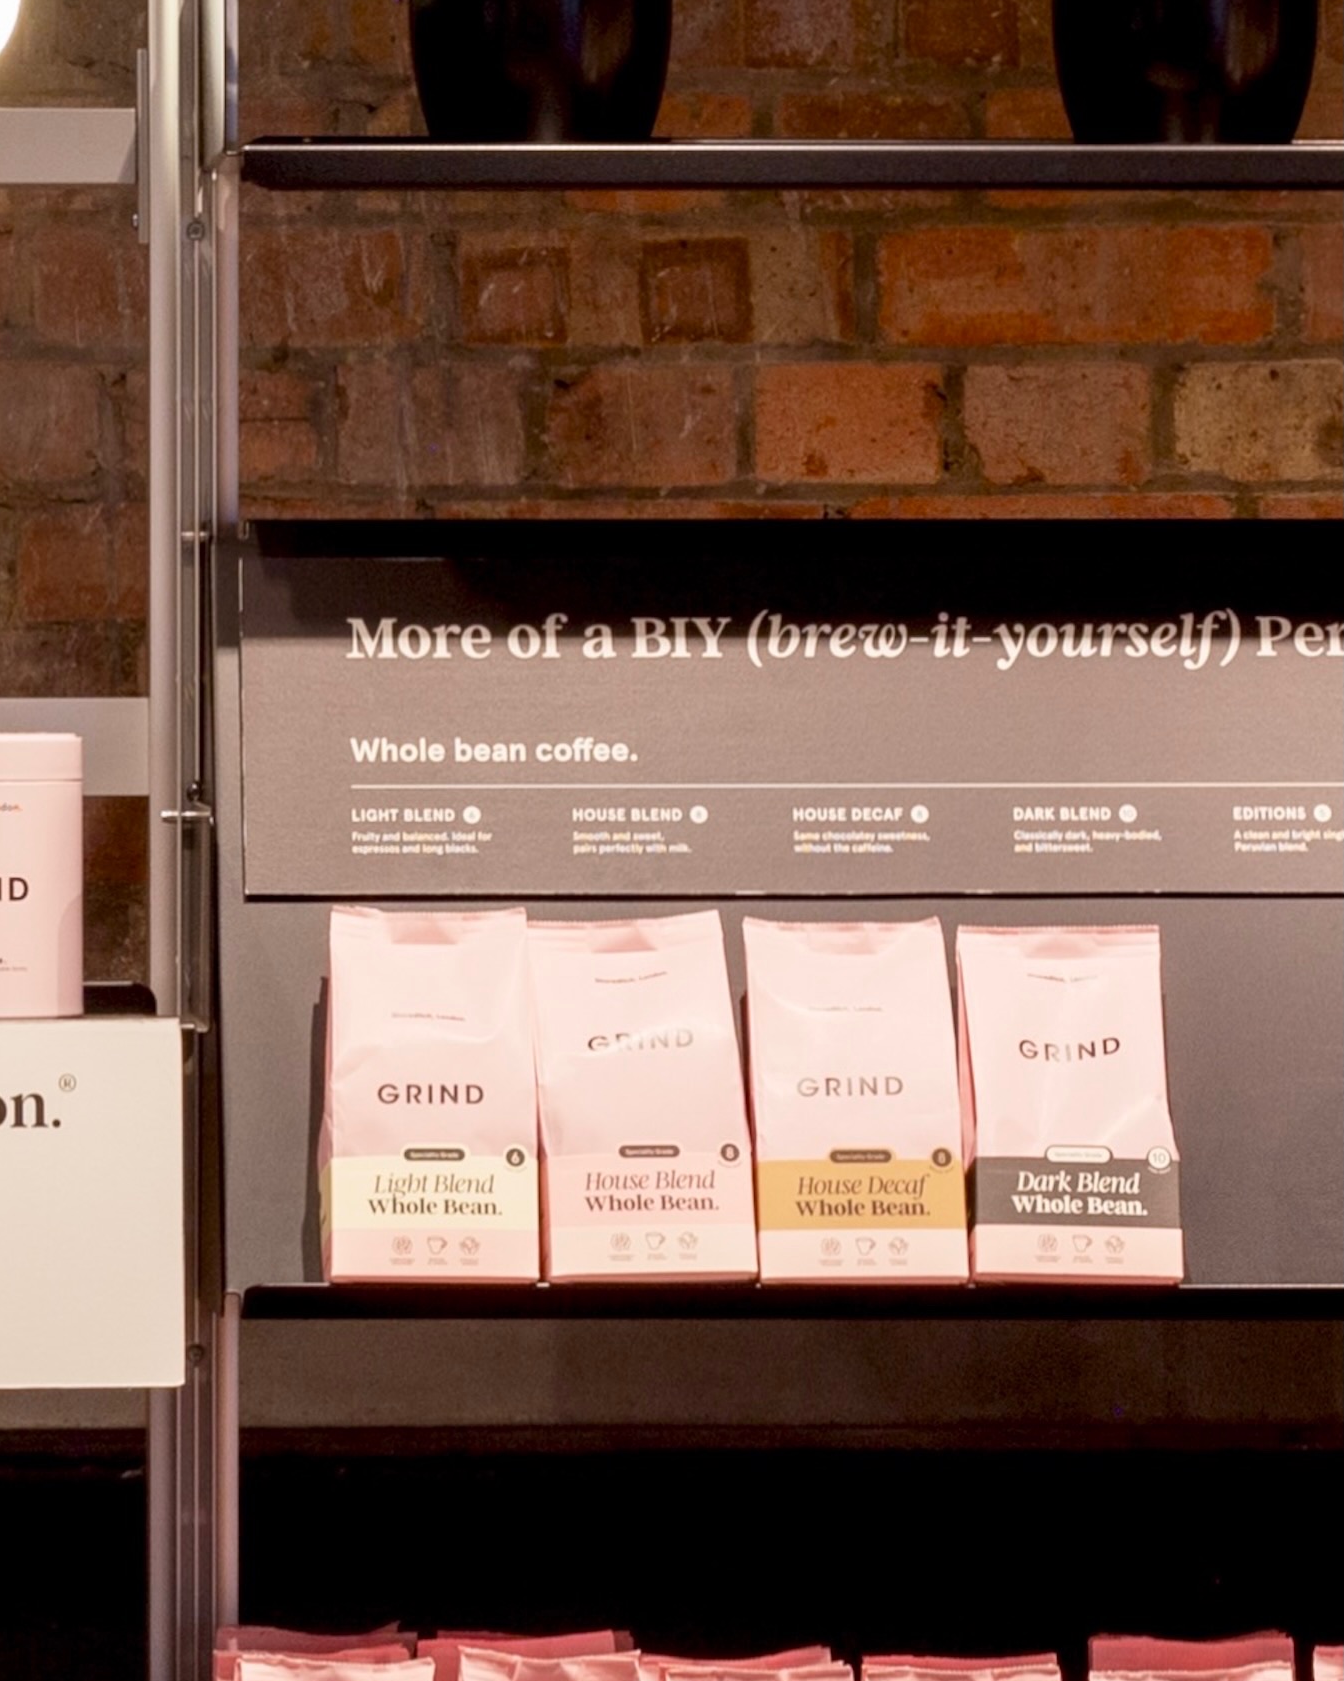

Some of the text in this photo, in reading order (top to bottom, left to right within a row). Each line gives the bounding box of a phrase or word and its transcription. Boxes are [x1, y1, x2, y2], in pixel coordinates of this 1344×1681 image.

[347, 617, 491, 659] More
[508, 613, 568, 659] of
[582, 626, 616, 659] a
[631, 617, 731, 659] BIY
[747, 608, 1241, 671] (brew-it-yourself)
[349, 736, 638, 763] Whole bean coffee.
[351, 807, 456, 823] LIGHT BLEND
[572, 807, 683, 822] HOUSE BLEND
[792, 807, 904, 822] HOUSE DECAF
[1012, 806, 1112, 822] DARK BLEND
[1232, 805, 1307, 821] EDITIONS
[1018, 1037, 1121, 1061] GRIND
[377, 1083, 484, 1105] GRIND
[797, 1076, 904, 1098] GRIND
[374, 1173, 495, 1199] Light Blend
[798, 1173, 930, 1201] House Decaf
[1017, 1170, 1141, 1195] Dark Blend
[368, 1197, 503, 1217] Whole Bean.
[795, 1198, 931, 1217] Whole Bean.
[1011, 1193, 1149, 1216] Whole Bean.
